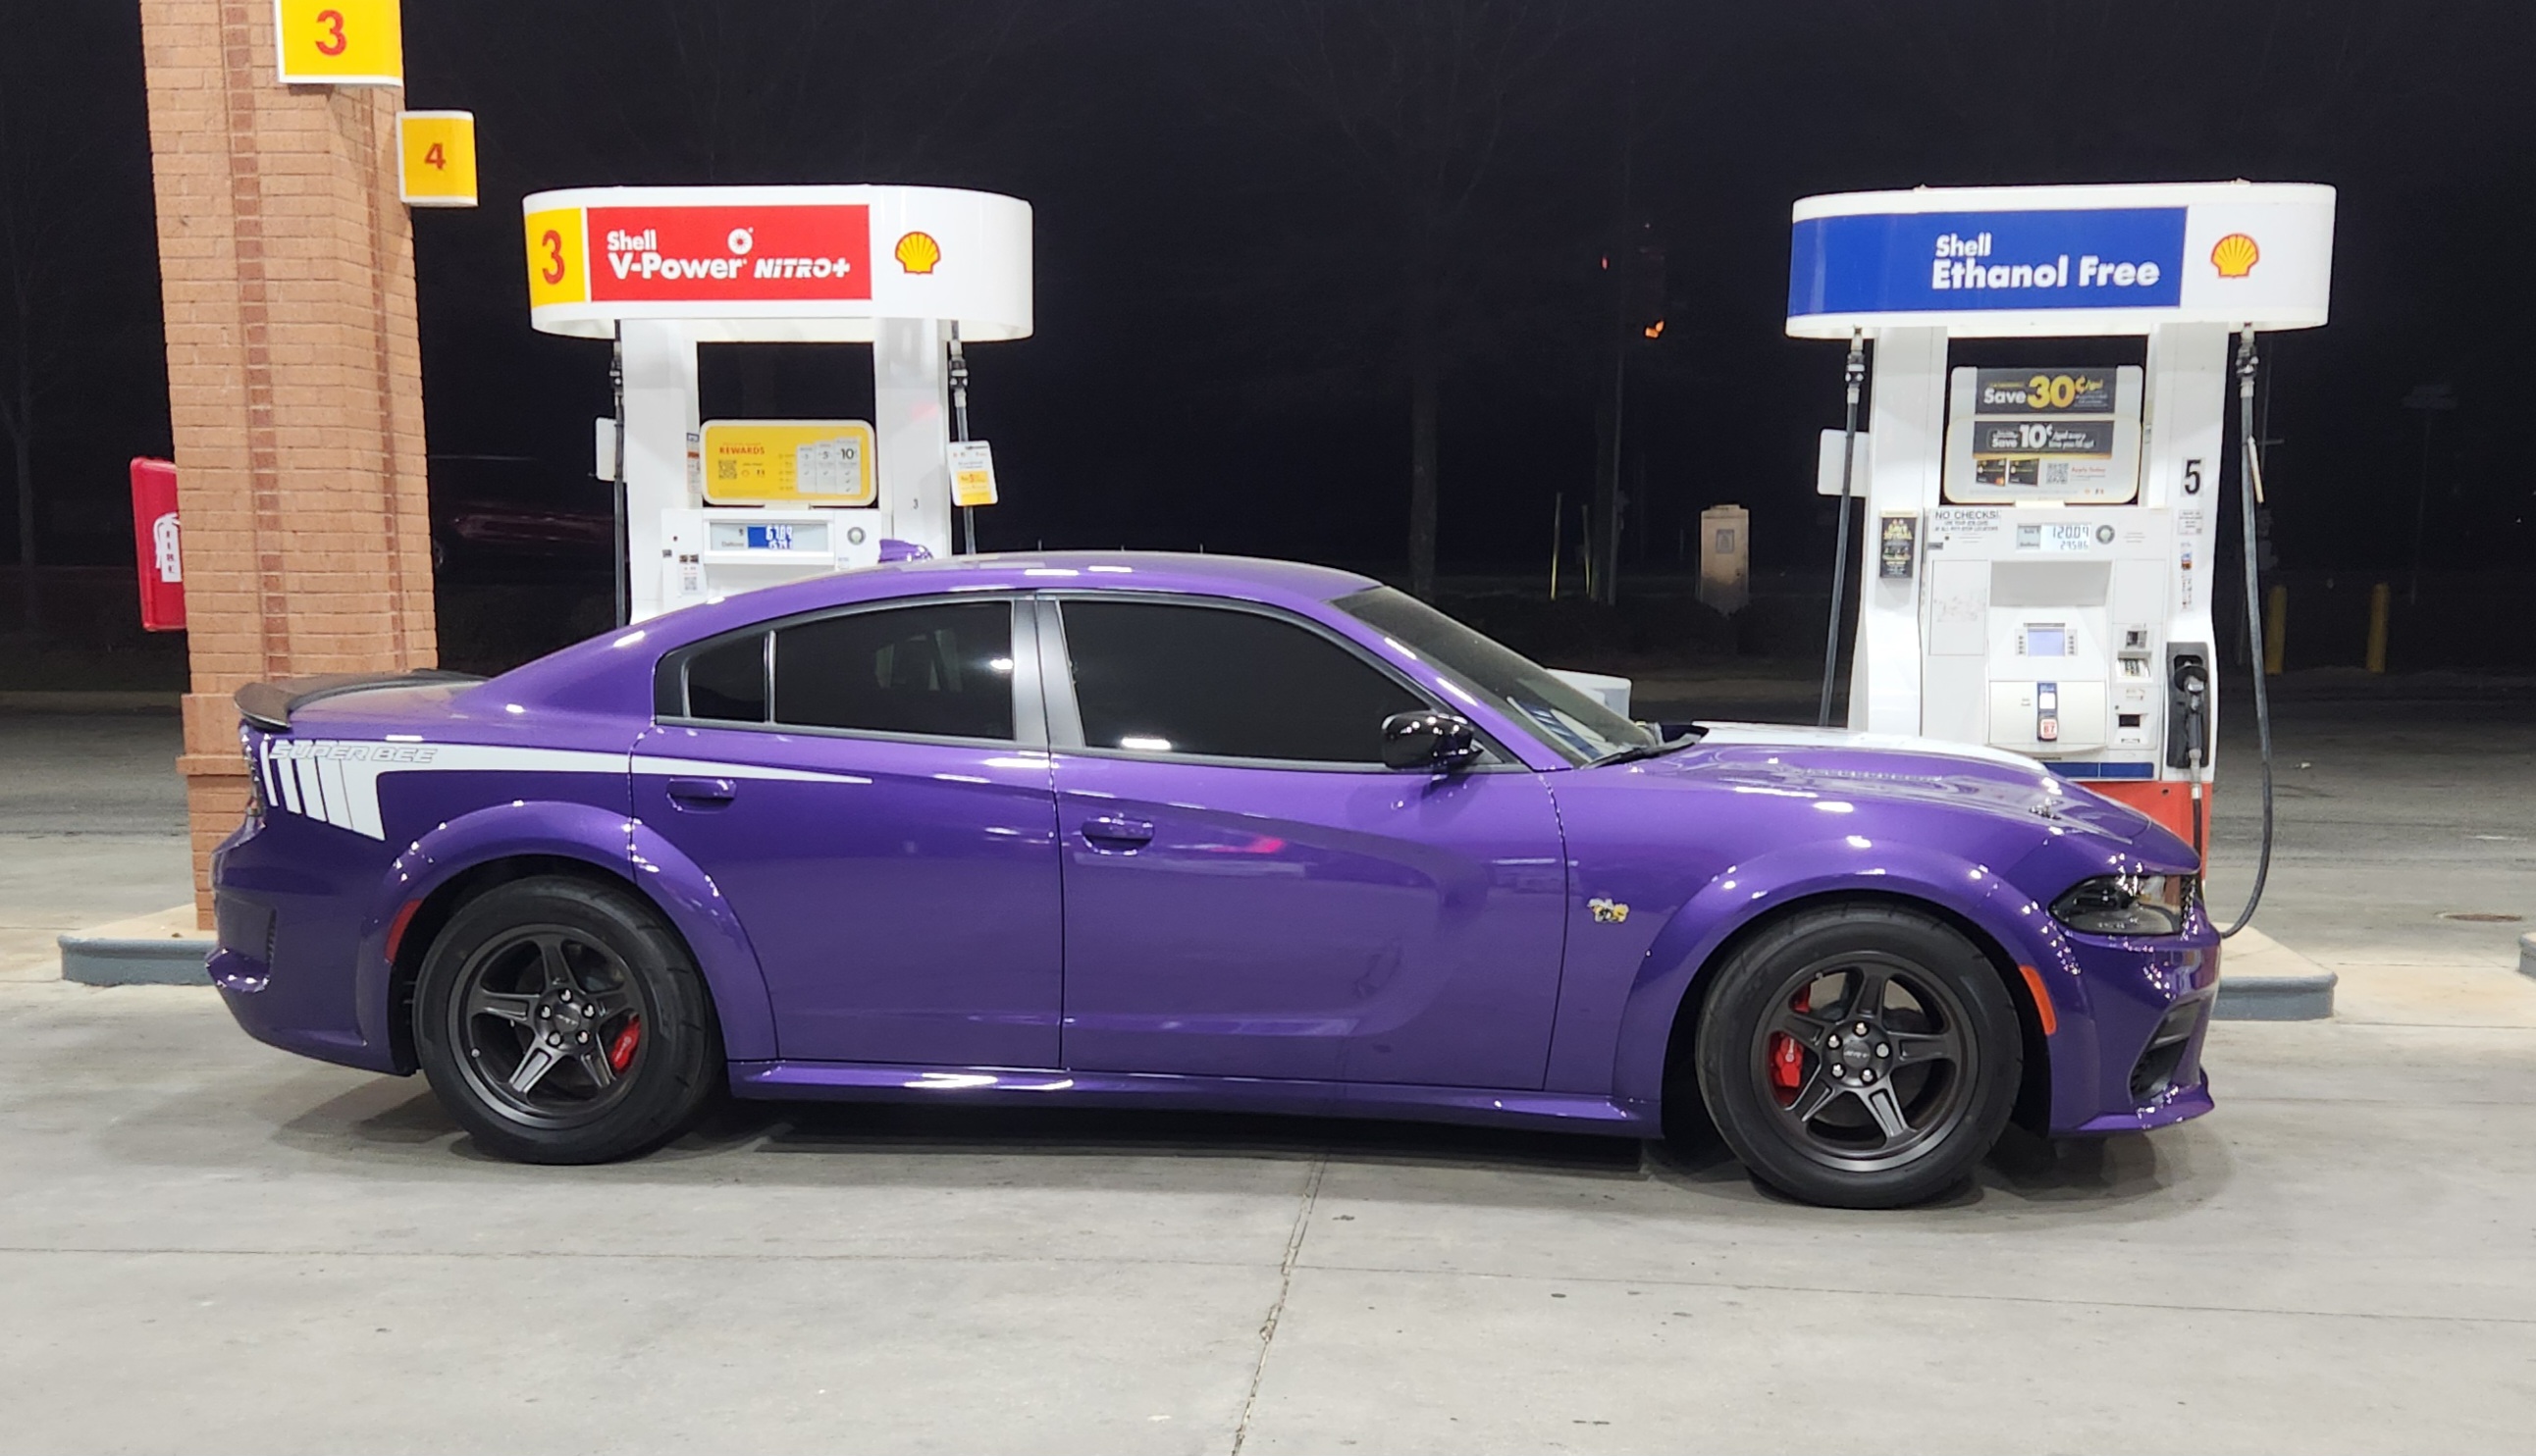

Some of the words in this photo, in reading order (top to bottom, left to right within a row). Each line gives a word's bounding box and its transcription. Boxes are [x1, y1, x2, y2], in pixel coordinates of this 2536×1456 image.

[315, 10, 347, 57] 3
[424, 142, 447, 170] 4
[607, 229, 657, 251] Shell
[1935, 232, 1992, 257] Shell
[542, 230, 565, 285] 3
[608, 252, 744, 280] V-Power
[1931, 254, 2069, 289] Ethanol
[2079, 255, 2160, 286] Free
[1983, 388, 2027, 404] Save
[719, 446, 766, 455] REWARDS
[2185, 458, 2201, 495] 5
[1934, 510, 1950, 520] NO
[269, 744, 369, 761] SUPER
[371, 748, 438, 763] BEE
